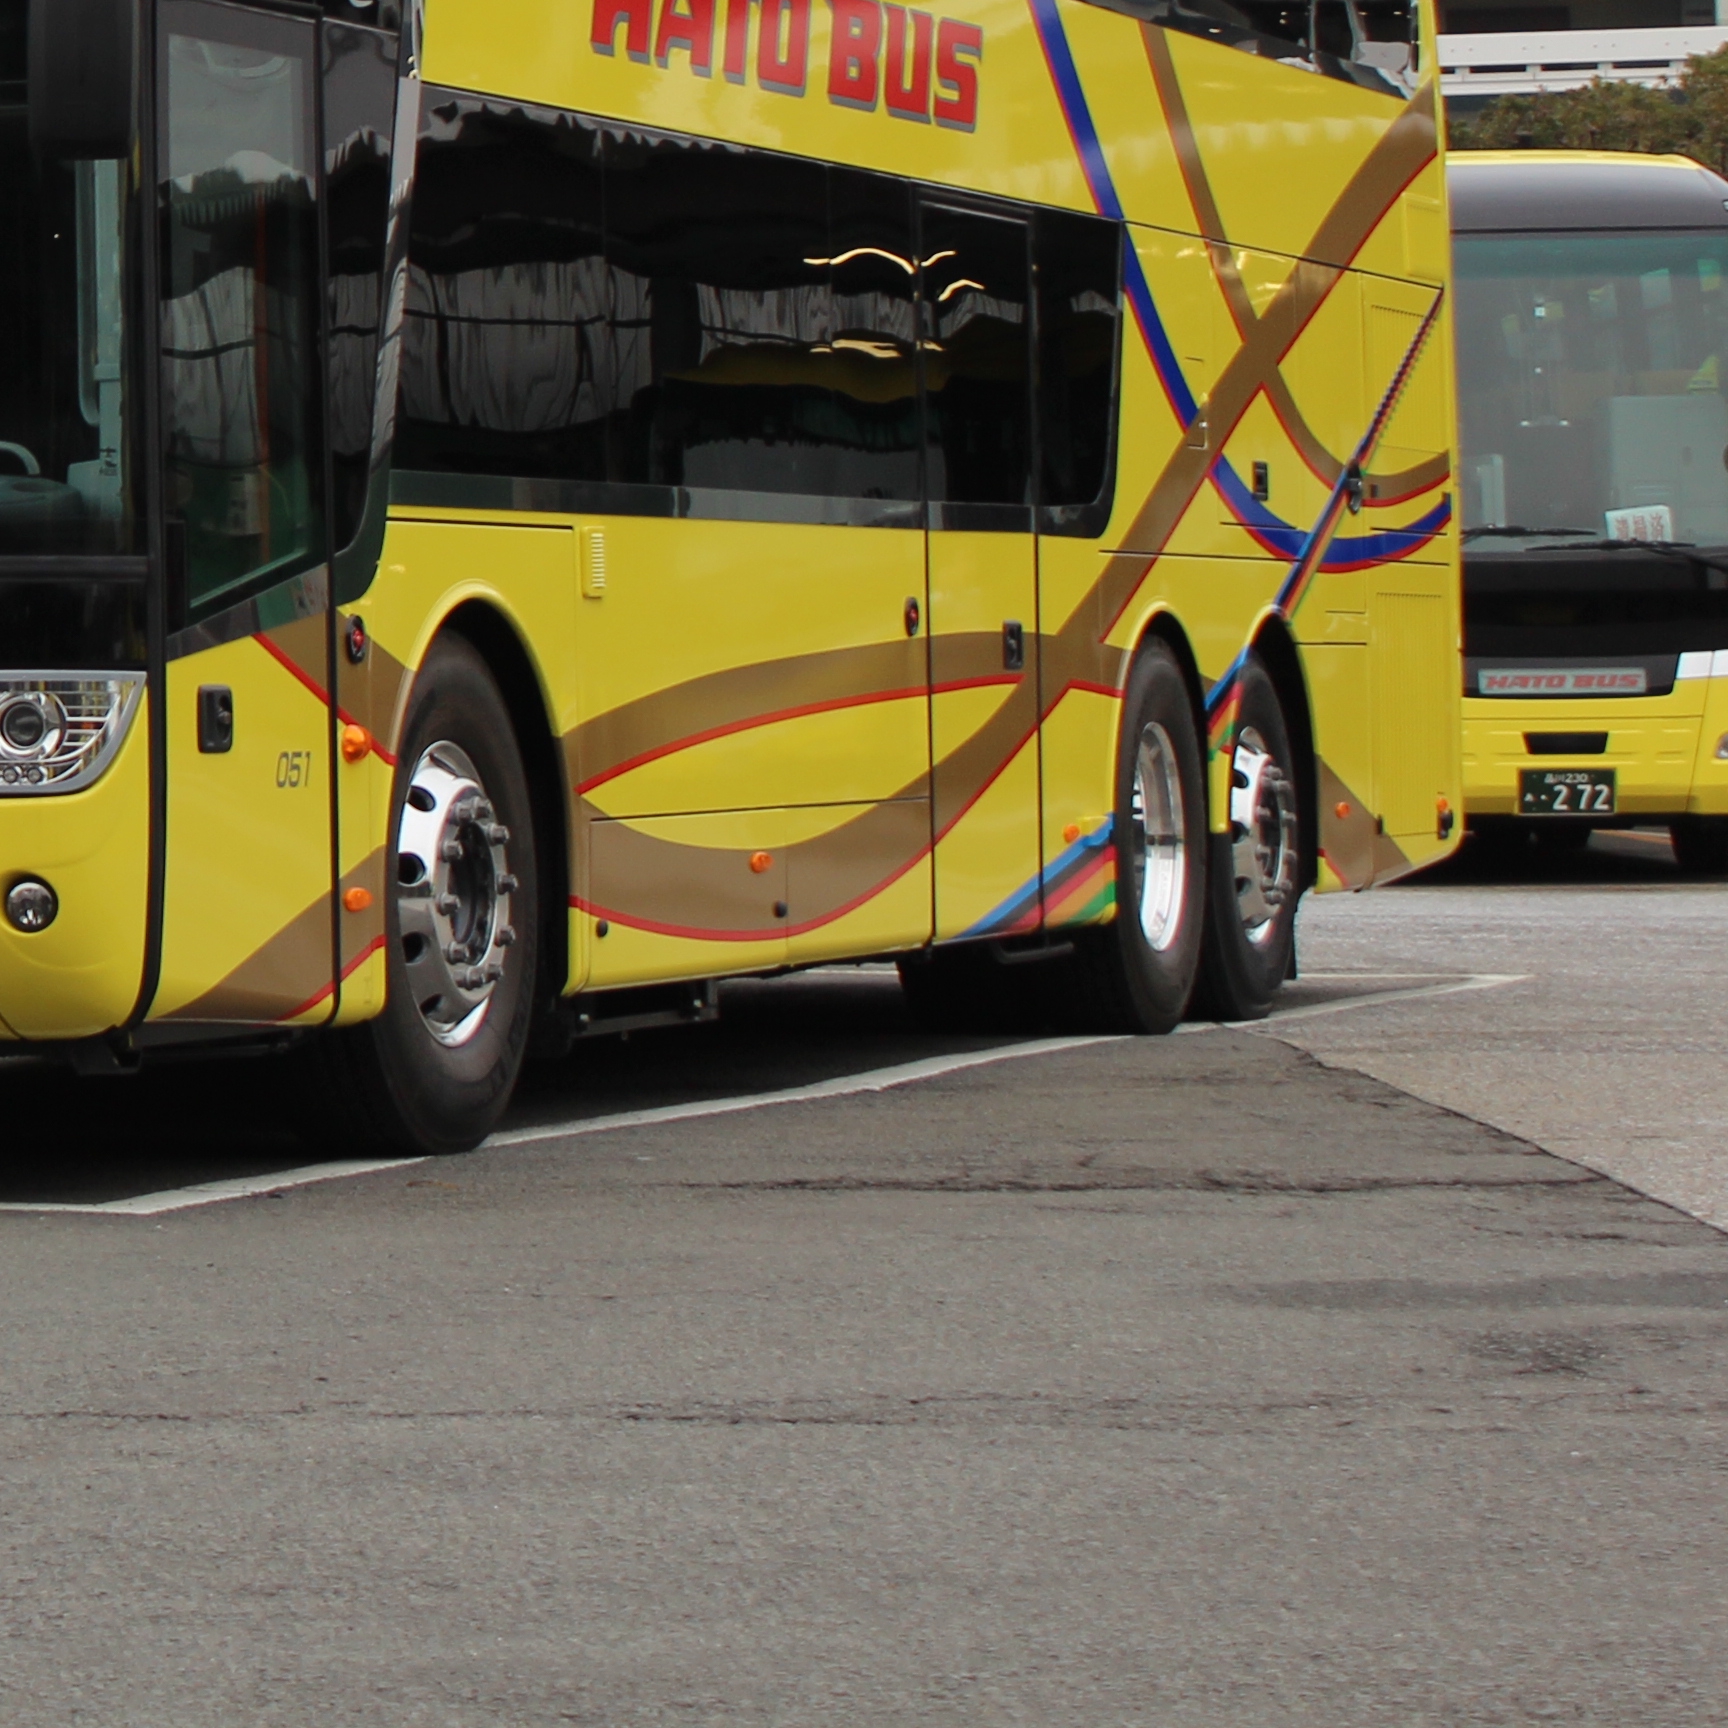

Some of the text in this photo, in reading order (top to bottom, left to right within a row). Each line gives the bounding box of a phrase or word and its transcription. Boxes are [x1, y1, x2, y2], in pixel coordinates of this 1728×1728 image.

[1484, 673, 1642, 689] HATO BUS
[276, 751, 310, 788] 051
